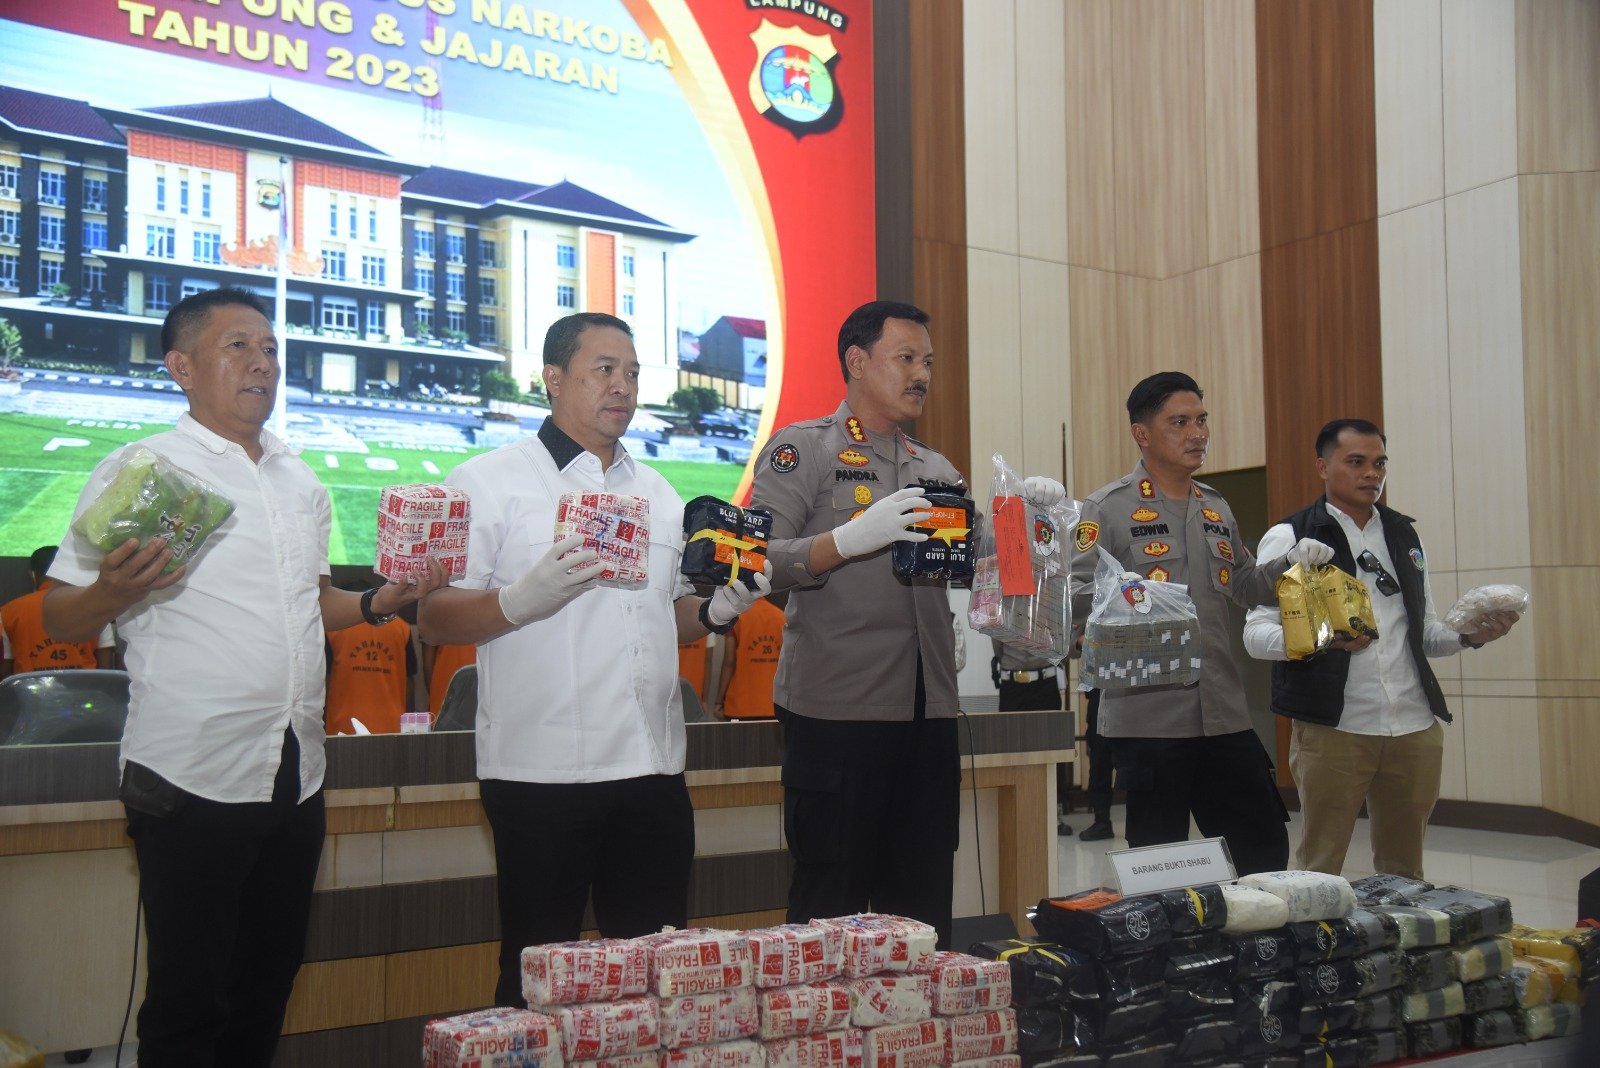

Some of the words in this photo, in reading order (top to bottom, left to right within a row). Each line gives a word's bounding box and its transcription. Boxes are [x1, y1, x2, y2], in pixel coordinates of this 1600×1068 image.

[471, 0, 673, 69] NARKOBA
[118, 0, 308, 71] TAHUN
[325, 47, 439, 97] 2023
[371, 13, 406, 47] &
[420, 26, 620, 95] JAJARAN
[835, 469, 879, 482] PANDRA
[402, 501, 444, 512] FRAGILE
[569, 506, 613, 526] FRAGILE
[387, 517, 424, 534] FRAGILE
[1130, 523, 1169, 538] EDWIN
[428, 538, 466, 551] FRAGILE
[50, 649, 67, 661] 45
[1132, 864, 1164, 875] BARANG
[1165, 860, 1187, 870] BUKTI
[1187, 857, 1212, 867] SHABU
[671, 977, 721, 995] FRAGILE
[467, 1037, 524, 1057] FRAGILE
[877, 1035, 920, 1053] FRAGILE
